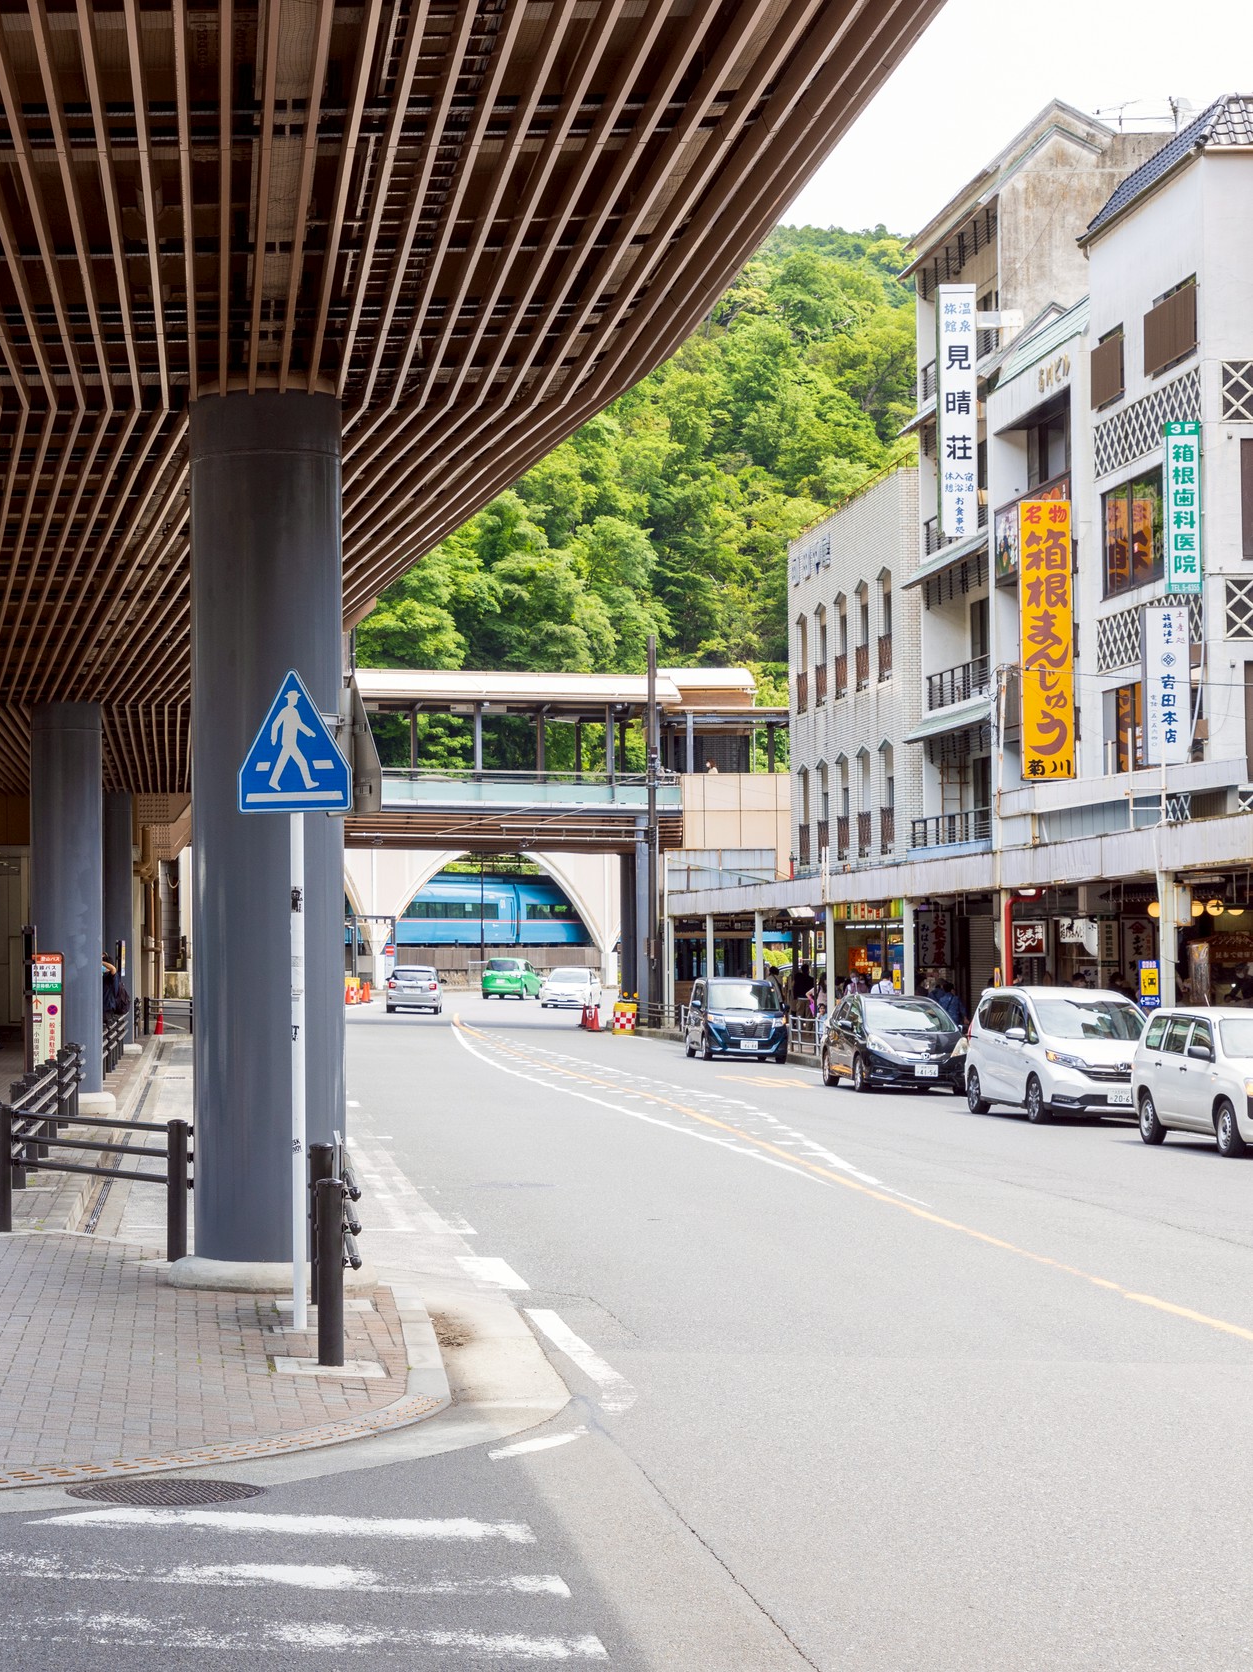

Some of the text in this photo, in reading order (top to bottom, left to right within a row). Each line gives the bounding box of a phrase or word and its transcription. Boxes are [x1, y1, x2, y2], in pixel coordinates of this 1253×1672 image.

[945, 345, 973, 460] 見晴荘
[1170, 423, 1196, 434] 3F
[1024, 504, 1068, 525] 名物
[1172, 444, 1197, 574] 箱根歯科医院
[1024, 528, 1069, 756] 箱根まんじゅう
[1027, 759, 1072, 776] 菊川
[920, 923, 930, 966] みはらし
